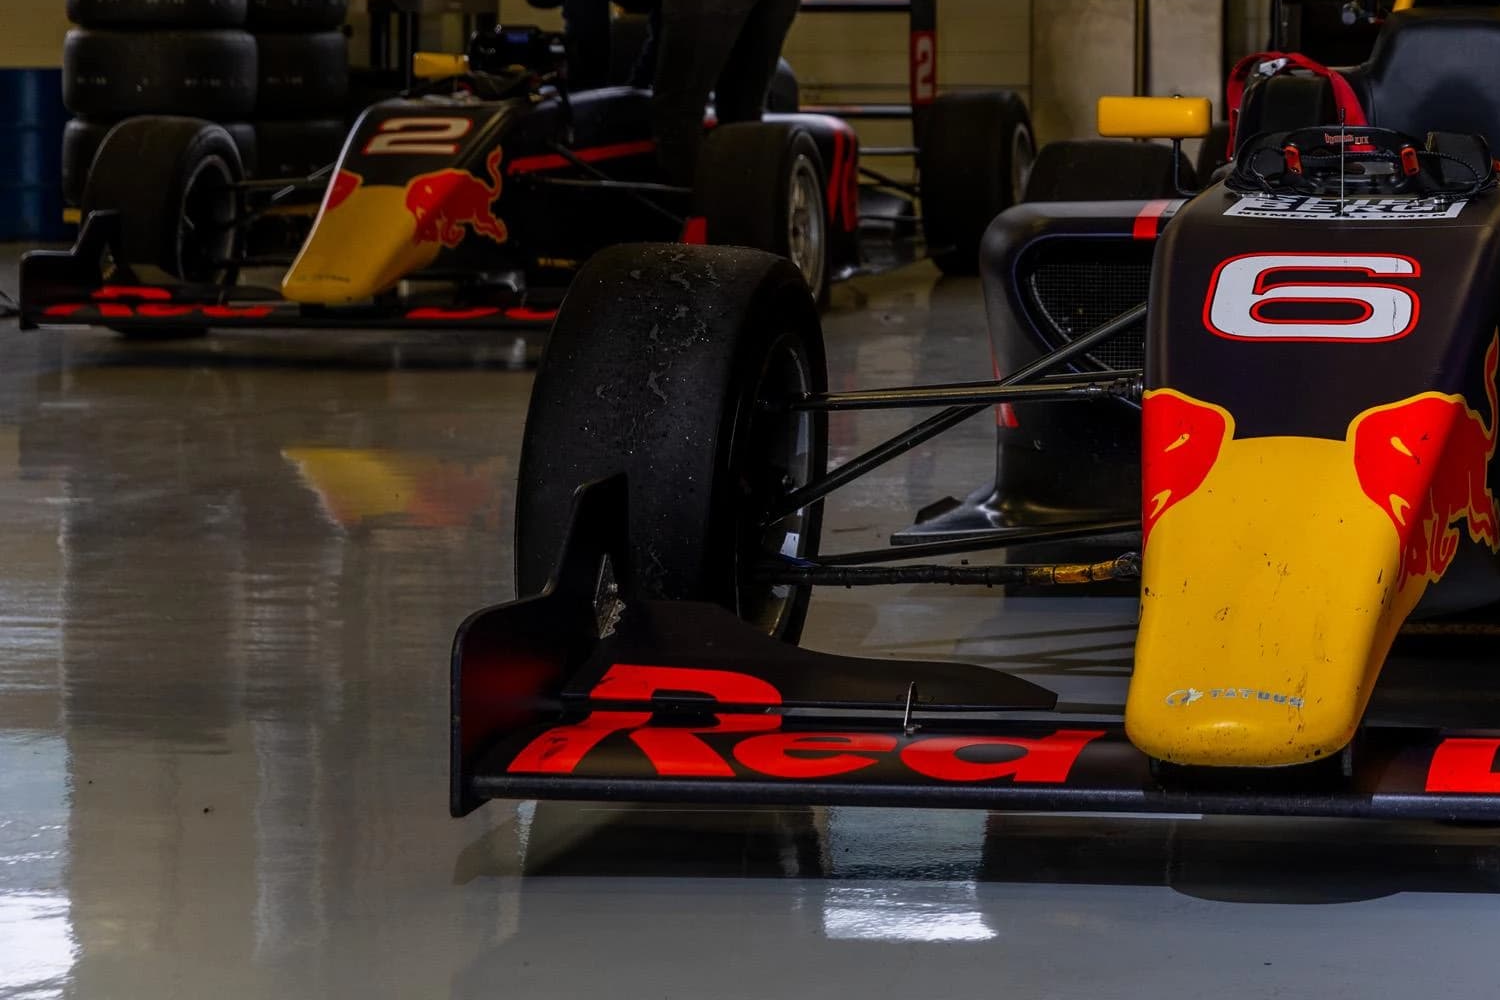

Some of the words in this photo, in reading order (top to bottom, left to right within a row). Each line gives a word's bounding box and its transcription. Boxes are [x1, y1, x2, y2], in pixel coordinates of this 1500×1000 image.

[362, 116, 472, 155] 2
[1202, 251, 1421, 343] 6
[506, 663, 1108, 783] Red
